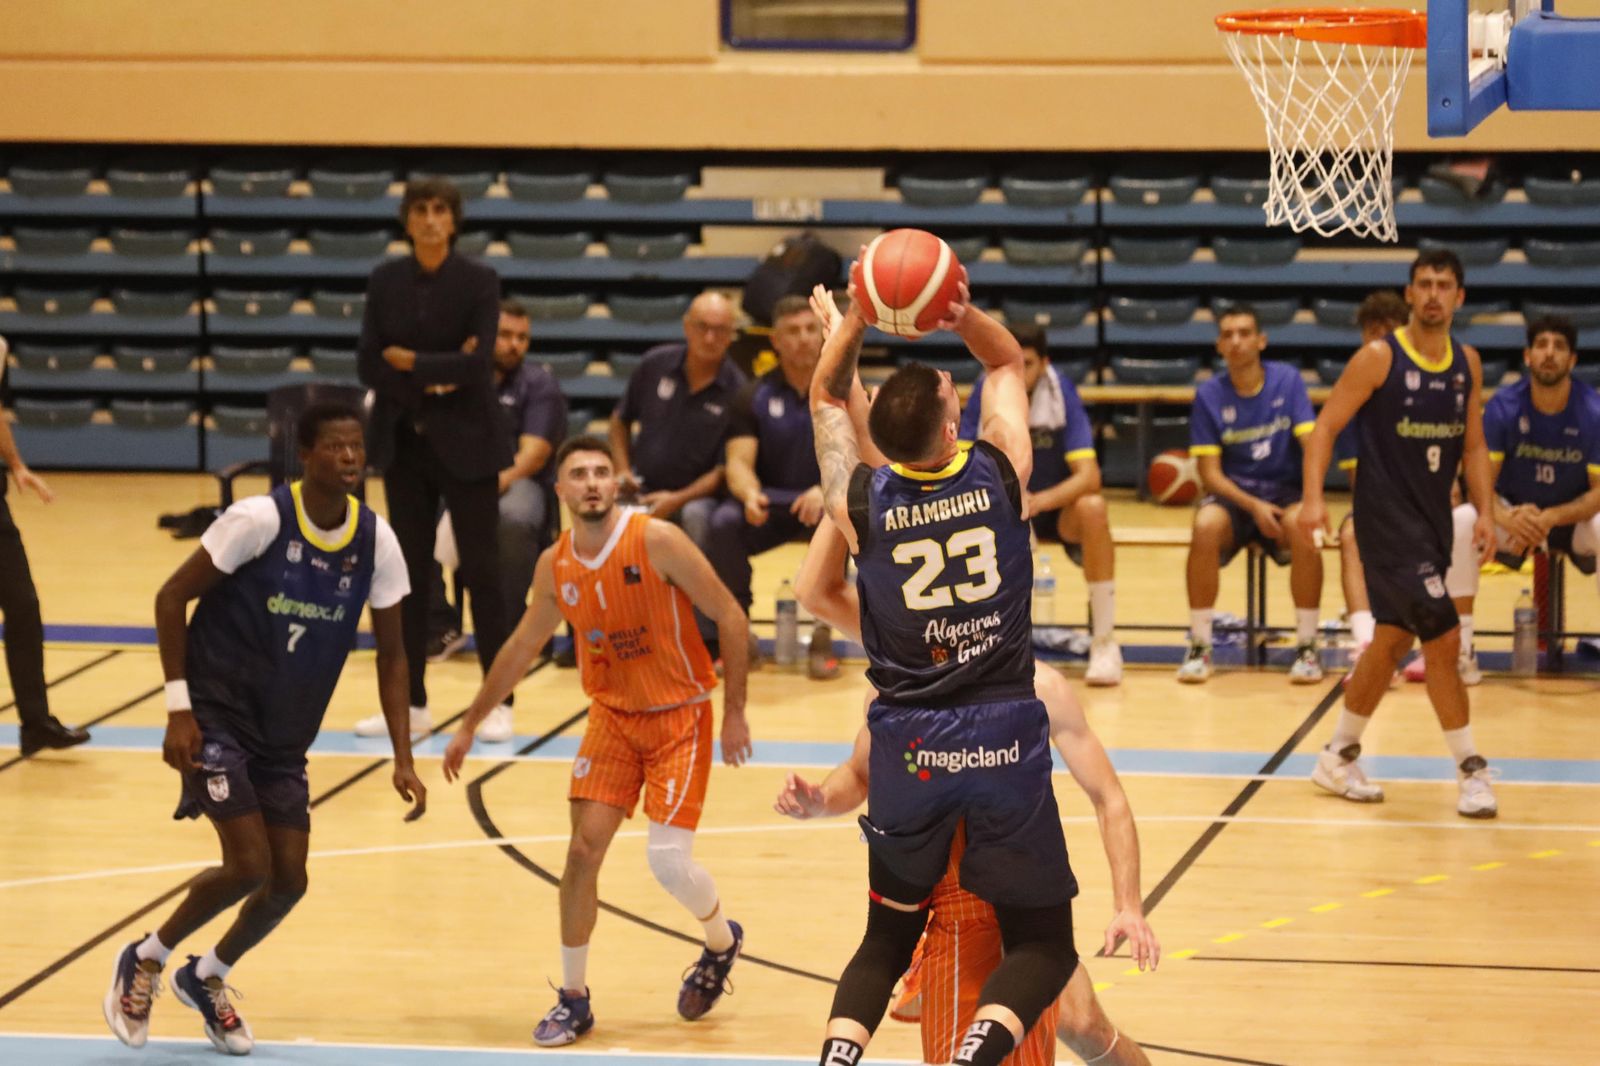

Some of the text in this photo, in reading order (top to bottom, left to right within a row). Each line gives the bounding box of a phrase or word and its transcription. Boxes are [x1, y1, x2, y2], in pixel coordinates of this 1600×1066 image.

[1426, 444, 1441, 473] 9
[1535, 463, 1555, 484] 10
[885, 488, 992, 532] ARAMBURU
[891, 526, 1002, 611] 23
[595, 580, 608, 610] 1
[287, 622, 306, 653] 7
[921, 610, 1001, 648] Algeciras
[916, 740, 1020, 774] magicland
